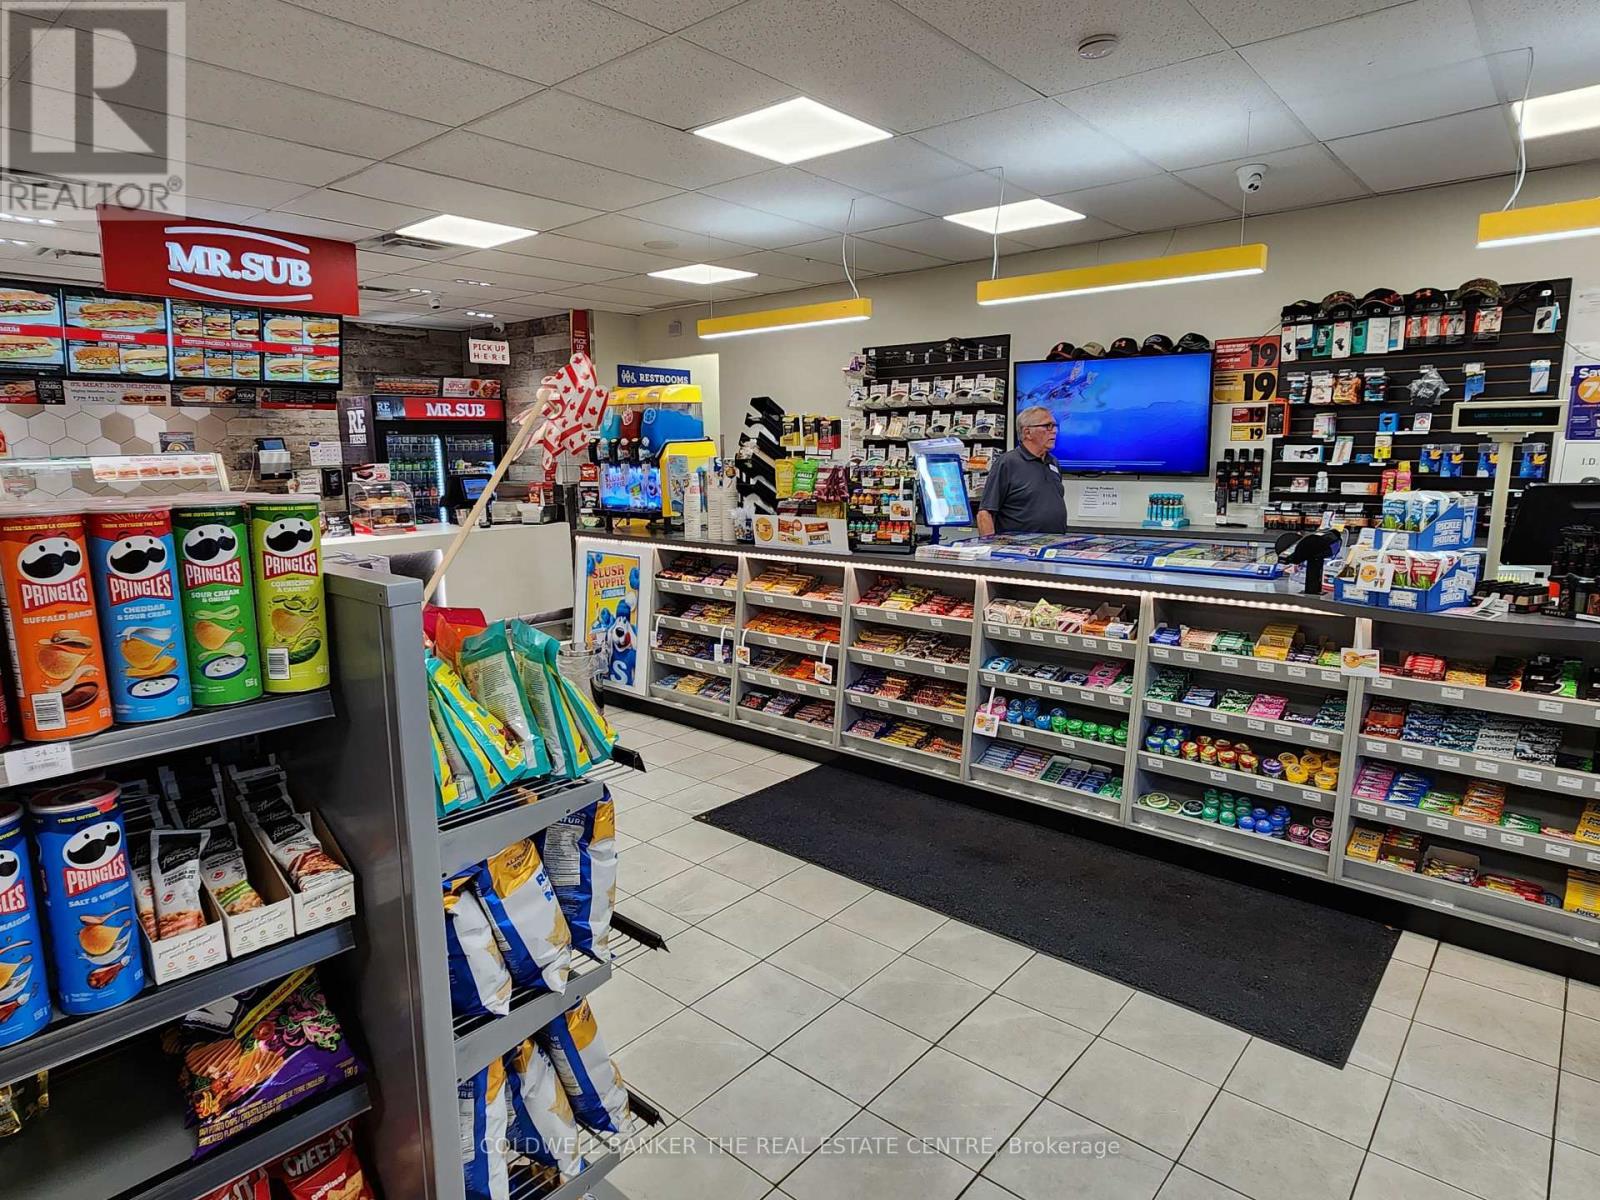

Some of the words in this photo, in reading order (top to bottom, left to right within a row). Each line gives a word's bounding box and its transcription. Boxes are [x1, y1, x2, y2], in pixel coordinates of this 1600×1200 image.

[166, 242, 312, 287] MR.SUB
[472, 343, 492, 352] PICK
[1250, 342, 1278, 369] 19
[639, 373, 689, 385] RESTROOMS
[1243, 372, 1276, 402] 19
[238, 391, 256, 399] WRAP
[425, 402, 486, 418] MR.SUB
[346, 409, 367, 435] RE
[1249, 428, 1264, 440] 19
[1436, 518, 1462, 533] PICKLE
[1433, 533, 1460, 547] POUCH
[265, 551, 317, 577] PRINGLES
[591, 563, 625, 579] SLUSH
[185, 560, 241, 587] PRINGLES
[109, 572, 172, 604] PRINGLES
[592, 576, 626, 592] PUPPIE
[21, 577, 89, 610] PRINGLES
[191, 591, 212, 600] SOUR
[213, 589, 240, 598] CREAM
[123, 603, 166, 614] CHEDDAR
[124, 612, 147, 621] SOUR
[148, 609, 172, 619] CREAM
[23, 613, 66, 625] BUFFALO
[67, 609, 94, 620] RANCH
[611, 660, 628, 685] S
[1402, 734, 1436, 743] Dentyne
[1438, 738, 1474, 747] Dentyne
[1479, 732, 1517, 741] Dentyne
[1476, 744, 1514, 752] Dentyne
[1516, 751, 1556, 761] Dentyne
[65, 855, 127, 896] PRINGLES
[68, 899, 90, 909] SALT
[343, 1068, 354, 1079] 190
[225, 1116, 238, 1128] CHIPS
